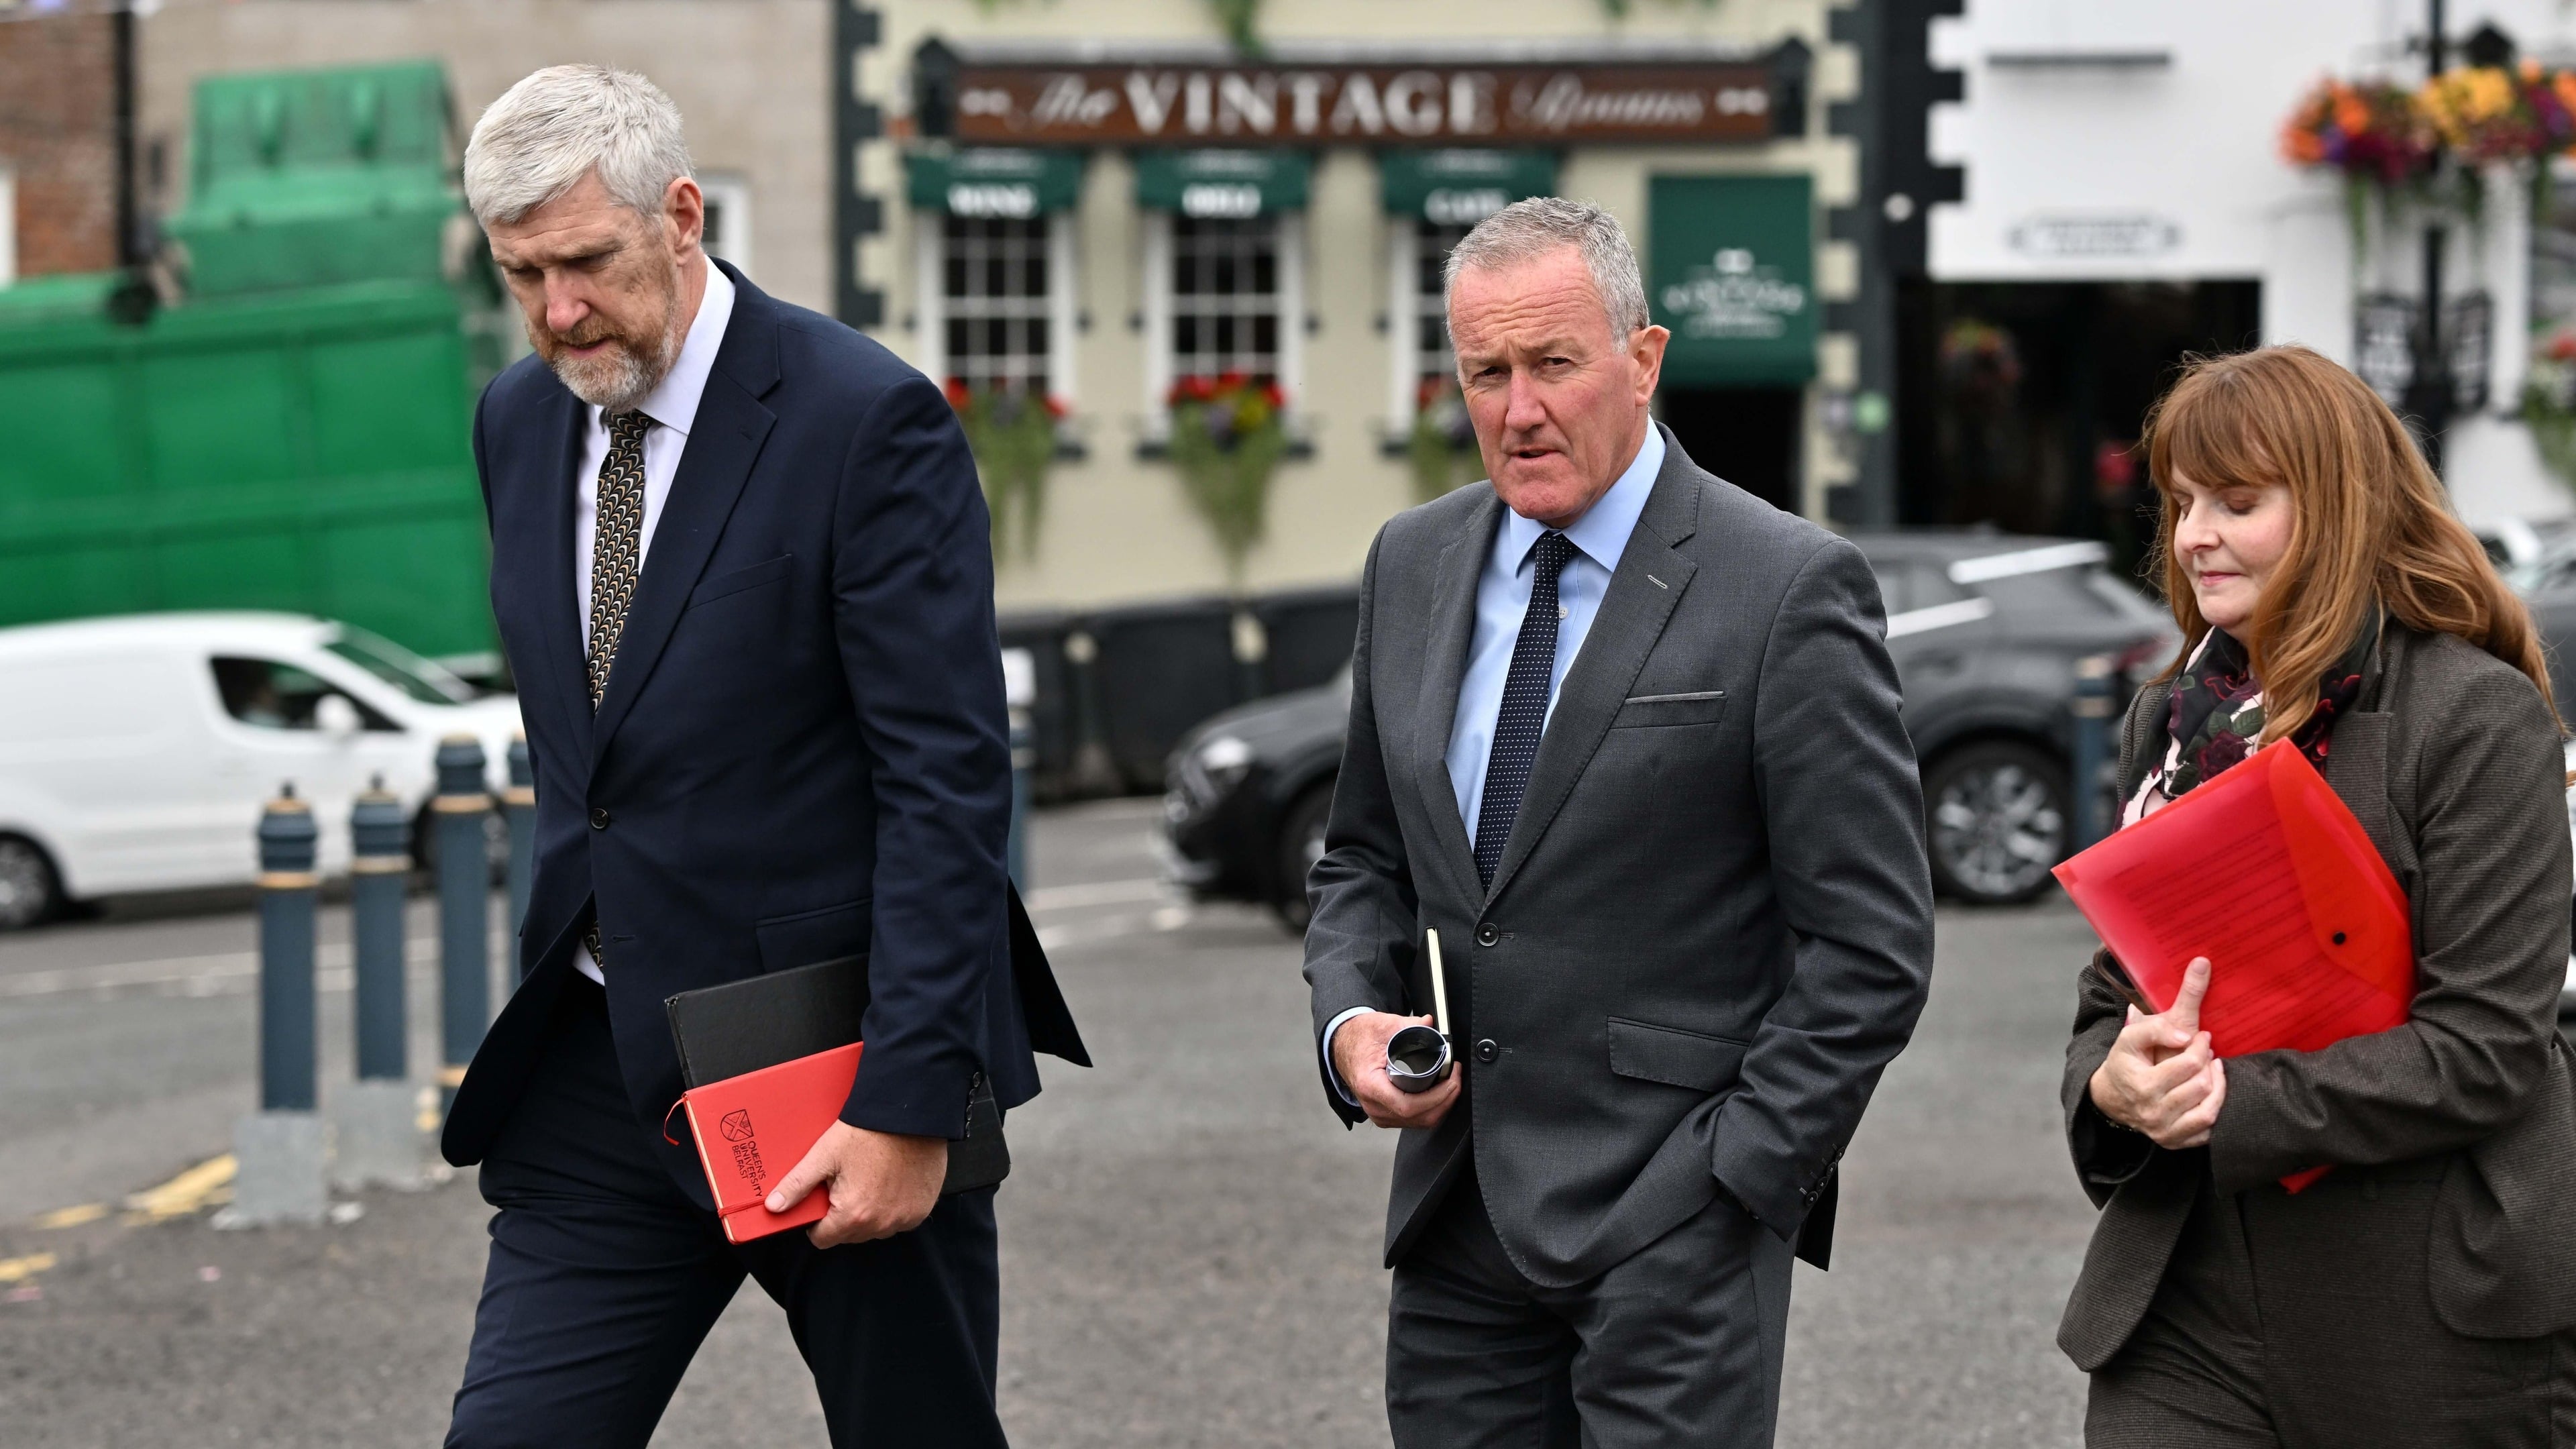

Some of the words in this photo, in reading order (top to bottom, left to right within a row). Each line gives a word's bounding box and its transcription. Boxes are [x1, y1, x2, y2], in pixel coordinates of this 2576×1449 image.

[1124, 70, 1498, 135] VINTAGE
[732, 1144, 749, 1179] BELFAST
[740, 1142, 763, 1197] UNIVERSITY
[748, 1140, 766, 1180] QUEEN'S
